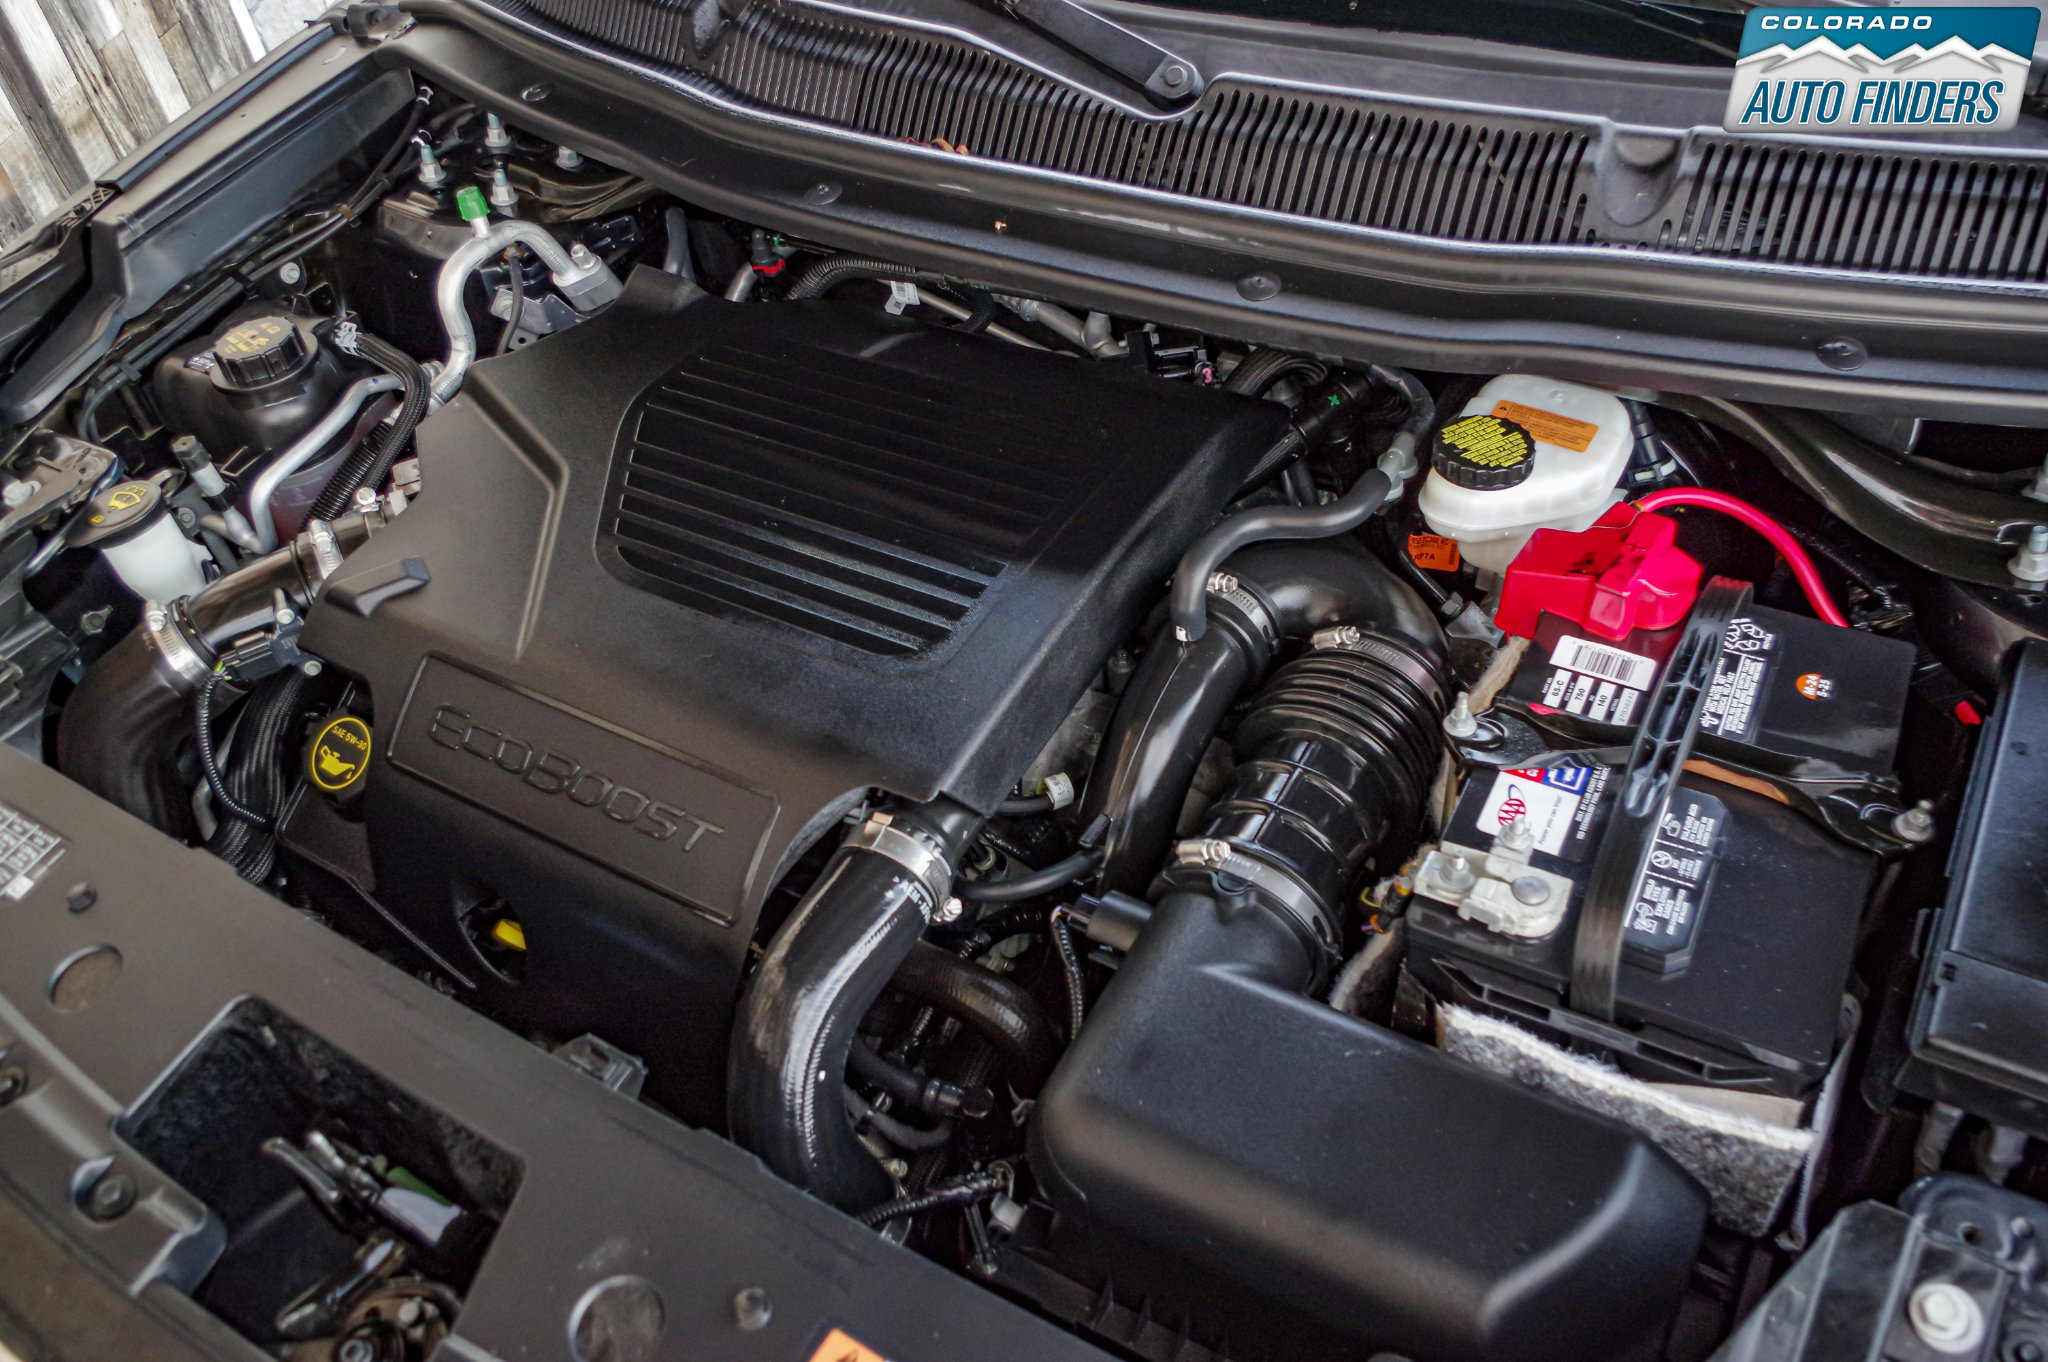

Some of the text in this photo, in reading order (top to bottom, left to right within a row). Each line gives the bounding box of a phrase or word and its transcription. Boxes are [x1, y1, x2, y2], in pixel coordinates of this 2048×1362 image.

[1552, 680, 1563, 696] 65-C
[1575, 688, 1585, 700] 750
[1598, 695, 1607, 706] 140
[333, 726, 346, 738] SAE
[429, 703, 725, 851] ECOBOOST
